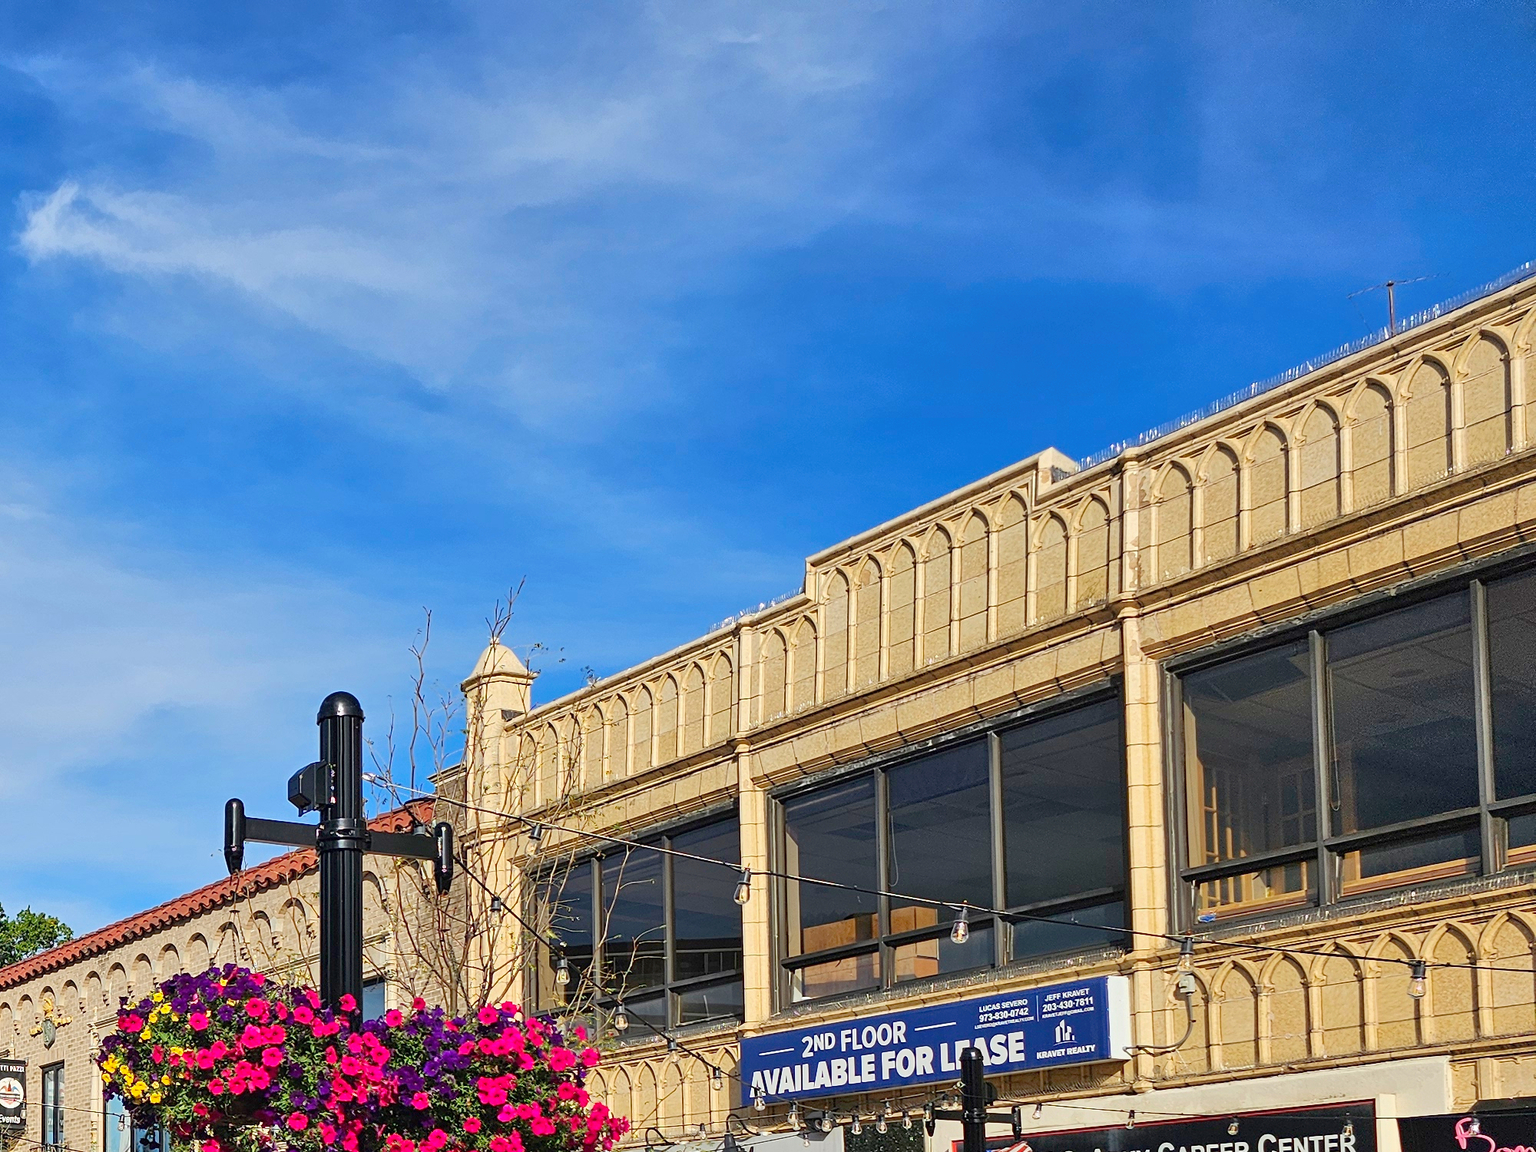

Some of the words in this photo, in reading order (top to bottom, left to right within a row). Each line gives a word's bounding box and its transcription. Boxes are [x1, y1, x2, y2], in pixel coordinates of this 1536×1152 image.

[1044, 993, 1061, 1002] JEFF
[1062, 987, 1090, 999] KRAVET
[978, 1003, 1000, 1013] LUCAS
[1001, 999, 1028, 1009] SEVERO
[1042, 996, 1094, 1013] 203-430-7811
[979, 1007, 1029, 1023] 973-830-0742
[801, 1032, 836, 1058] 2ND
[840, 1020, 907, 1052] FLOOR
[1036, 1048, 1065, 1060] KRAVET
[1066, 1044, 1096, 1055] REALTY
[749, 1053, 876, 1098] AVAILABLE
[881, 1045, 934, 1080] FOR
[939, 1030, 1025, 1073] LEASE
